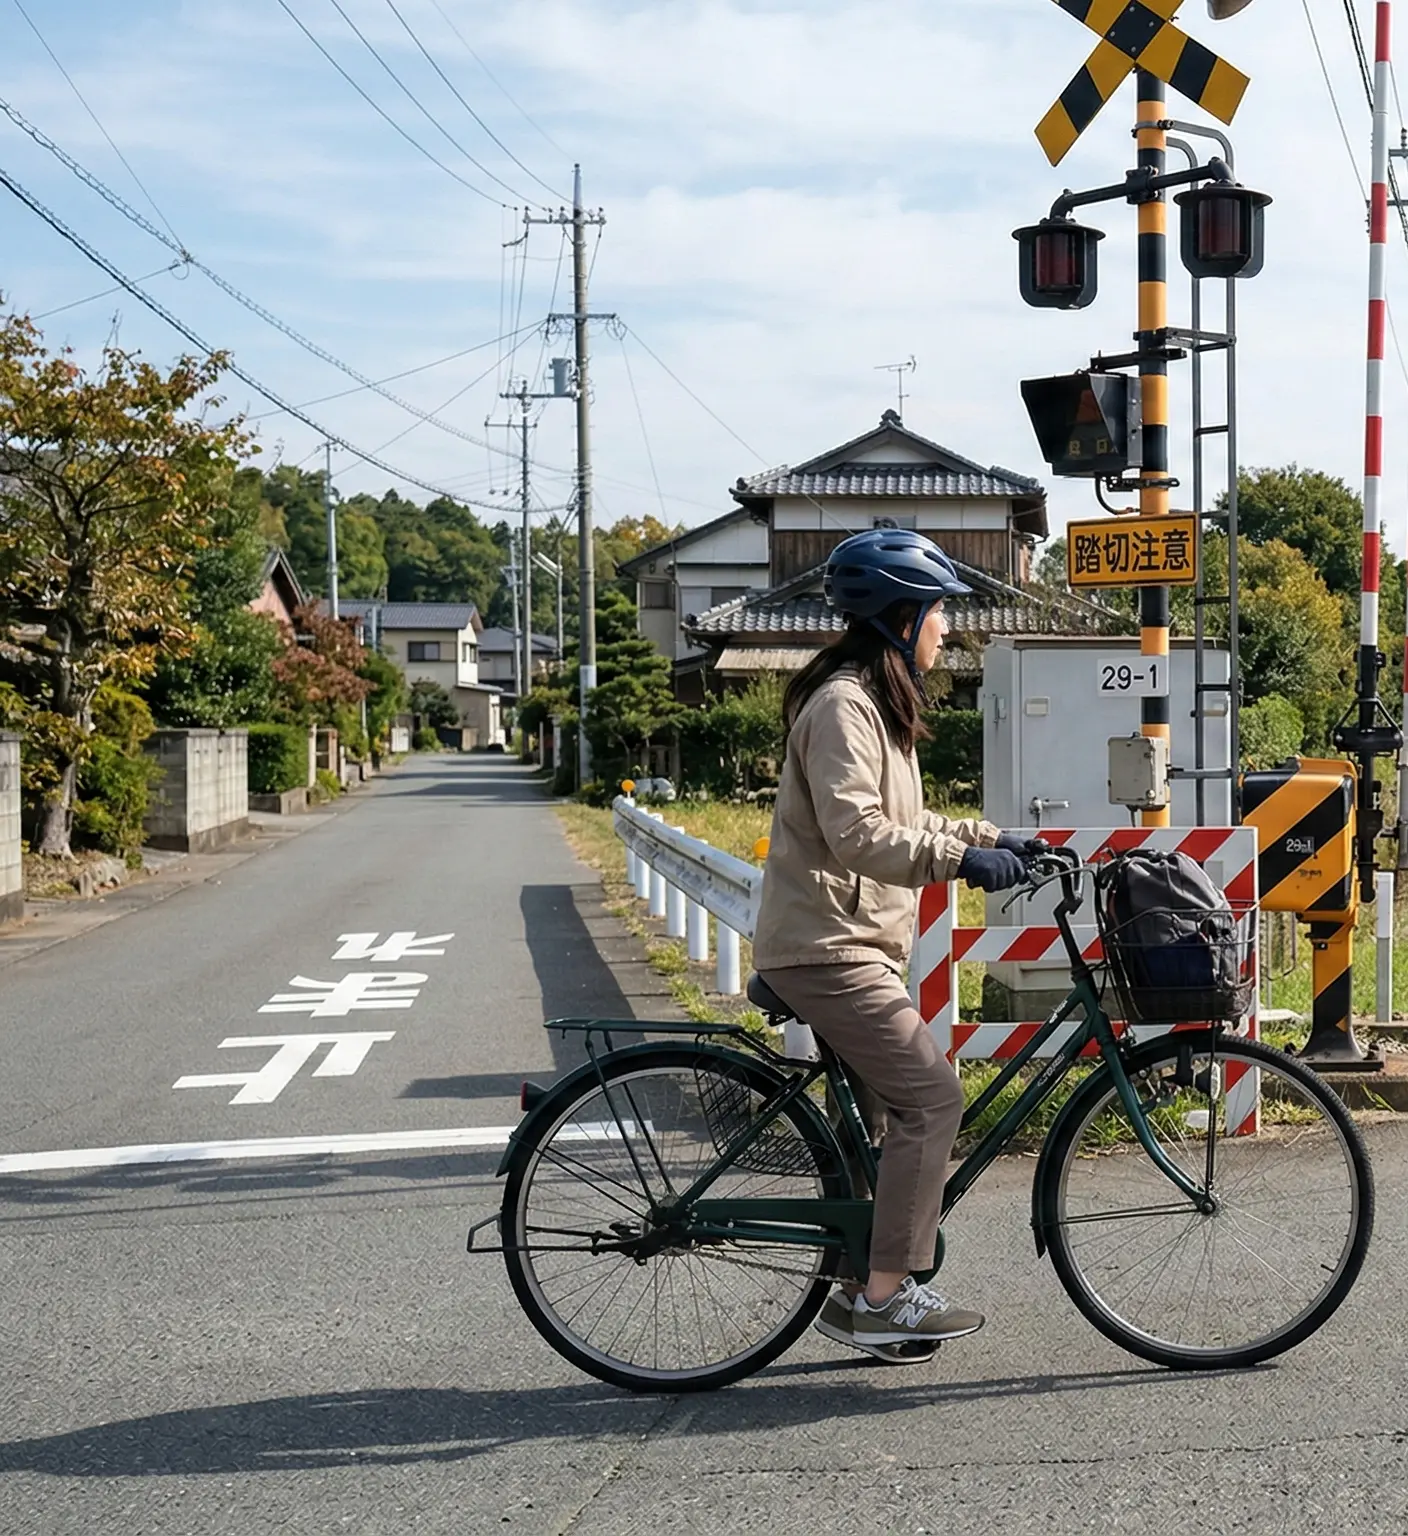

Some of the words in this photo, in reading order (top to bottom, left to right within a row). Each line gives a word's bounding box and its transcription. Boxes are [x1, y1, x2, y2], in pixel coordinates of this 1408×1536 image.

[1074, 528, 1191, 575] 踏切注意
[1101, 663, 1157, 691] 29-1
[171, 931, 455, 1105] 止まれ
[893, 1302, 929, 1329] N
